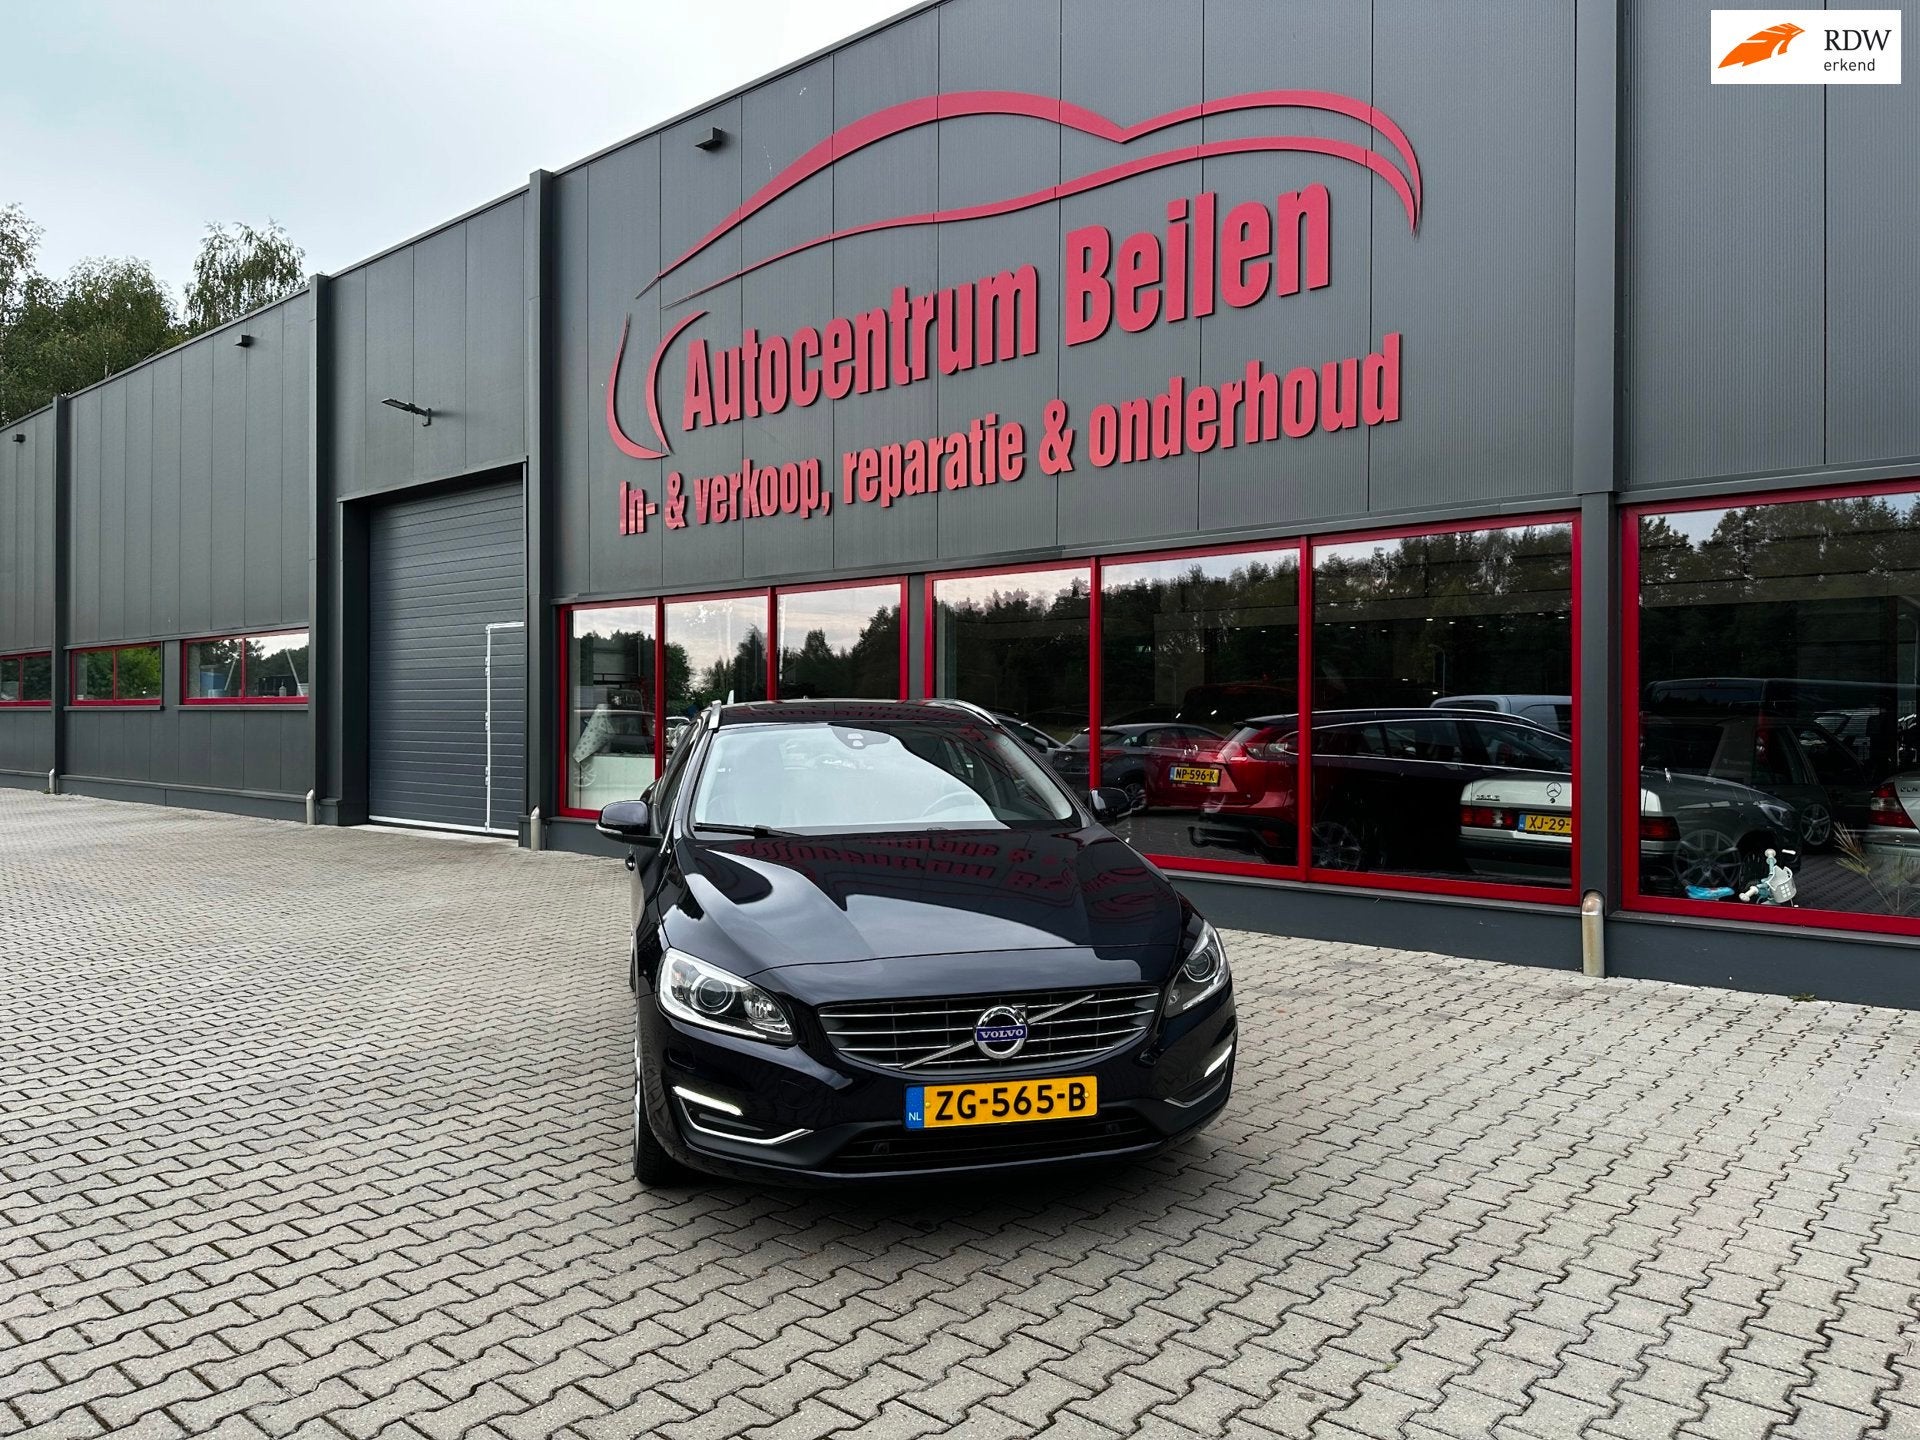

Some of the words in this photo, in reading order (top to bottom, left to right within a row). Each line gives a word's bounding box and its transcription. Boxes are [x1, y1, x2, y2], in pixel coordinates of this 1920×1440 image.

[682, 263, 1038, 430] Autocentrum
[1065, 183, 1330, 345] Beilen
[619, 480, 657, 535] In-
[665, 473, 689, 530] &
[693, 455, 831, 523] verkoop,
[842, 413, 1025, 508] reparatie
[1039, 399, 1074, 475] &
[1088, 332, 1401, 467] onderhoud
[1175, 768, 1215, 781] NP-596-K
[980, 1029, 1023, 1038] VOLVO
[935, 1082, 1086, 1121] ZG-565-B
[908, 1112, 922, 1121] NL
